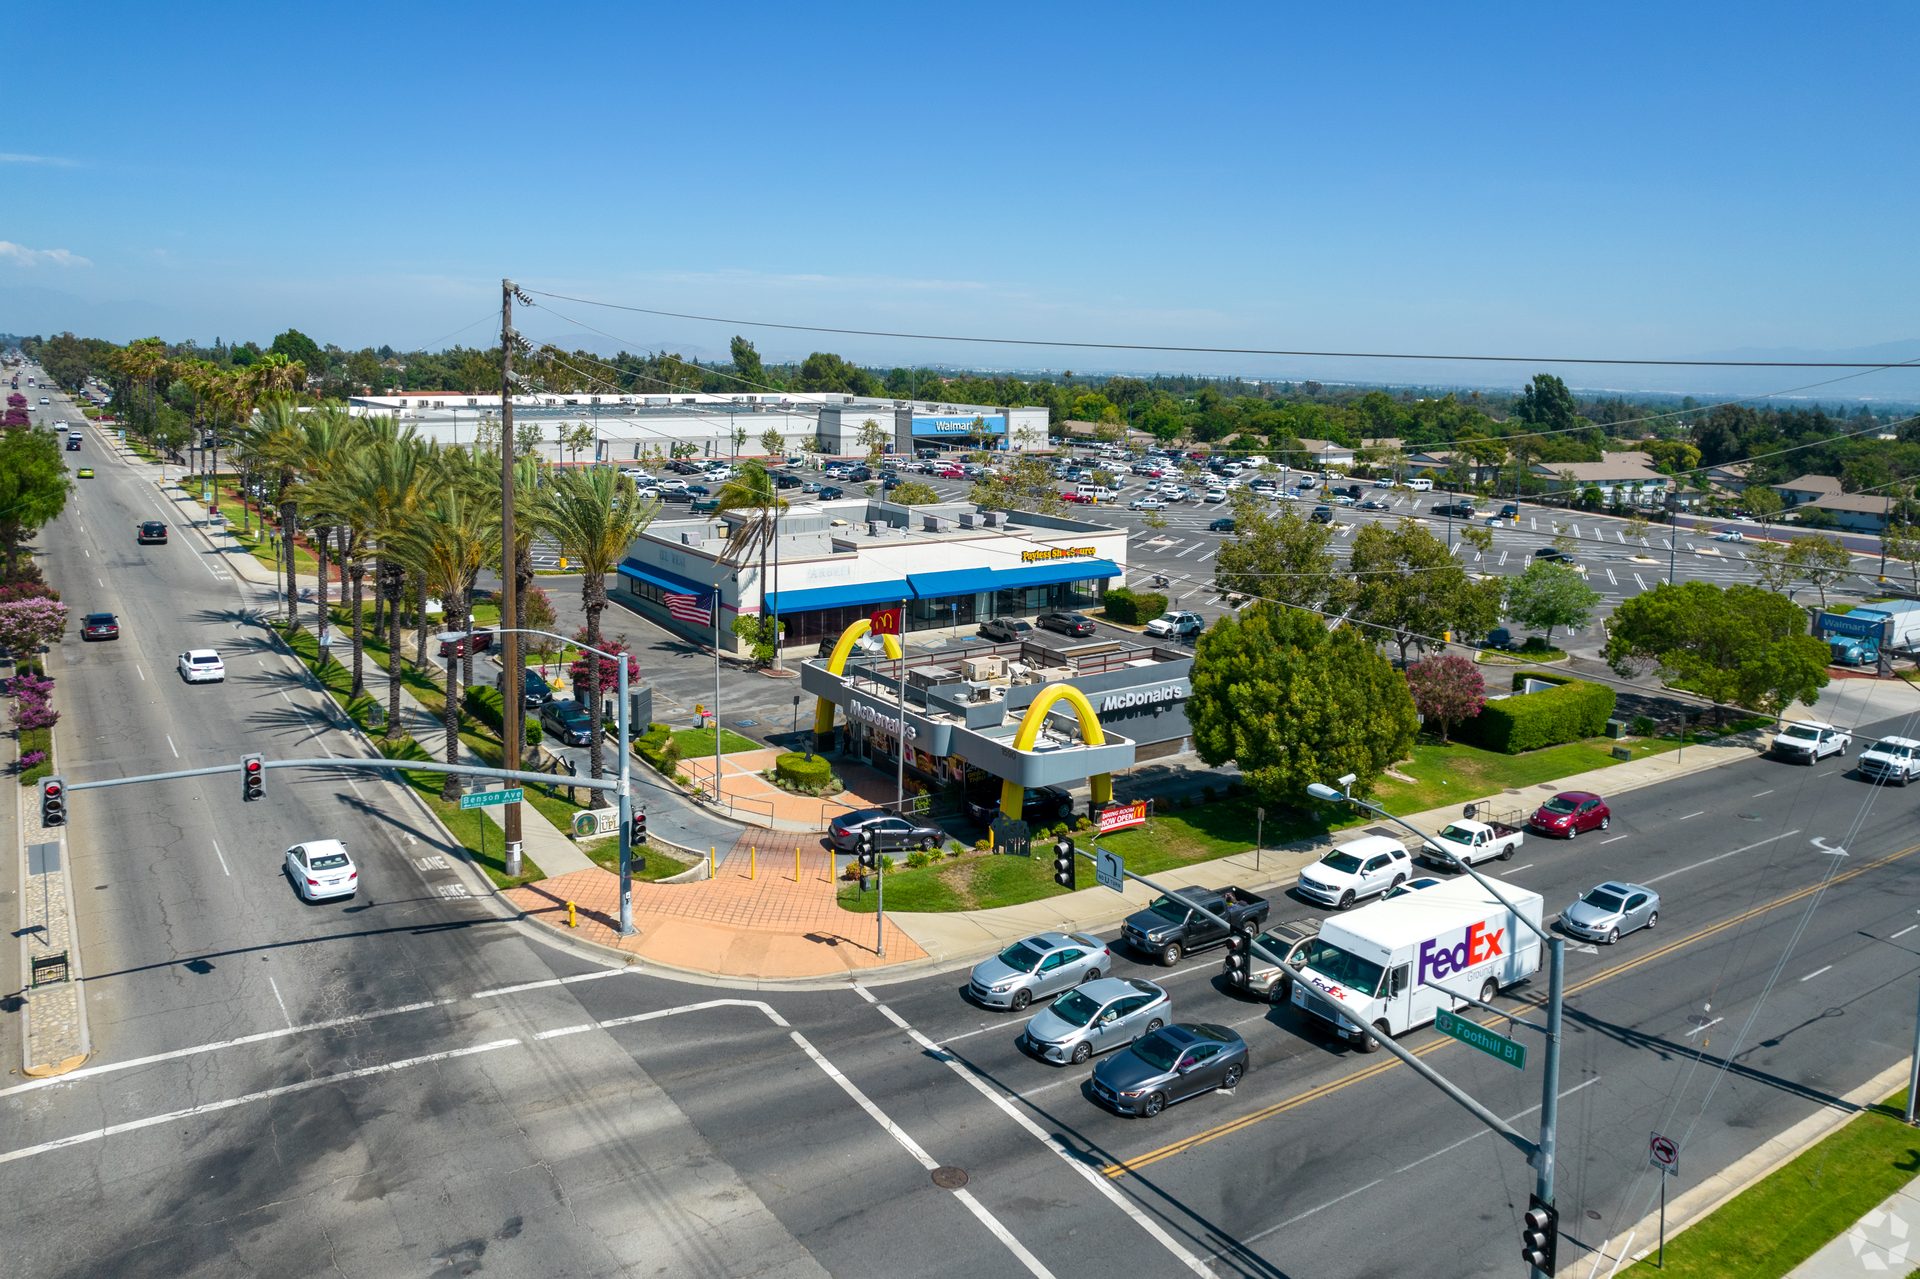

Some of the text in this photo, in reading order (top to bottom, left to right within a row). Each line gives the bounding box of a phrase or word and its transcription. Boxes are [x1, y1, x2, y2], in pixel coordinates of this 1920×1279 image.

[936, 420, 974, 431] Walmart
[1023, 550, 1051, 561] Payless
[1823, 618, 1867, 632] Walmart
[1104, 684, 1182, 711] McDonald's
[463, 795, 500, 804] Benson
[503, 791, 522, 799] Ave
[1102, 813, 1134, 827] NOW OPEN
[1105, 876, 1110, 884] U
[1417, 920, 1505, 986] FedEx
[1311, 977, 1348, 1001] FedEx
[1455, 1024, 1517, 1061] Foothill Bl
